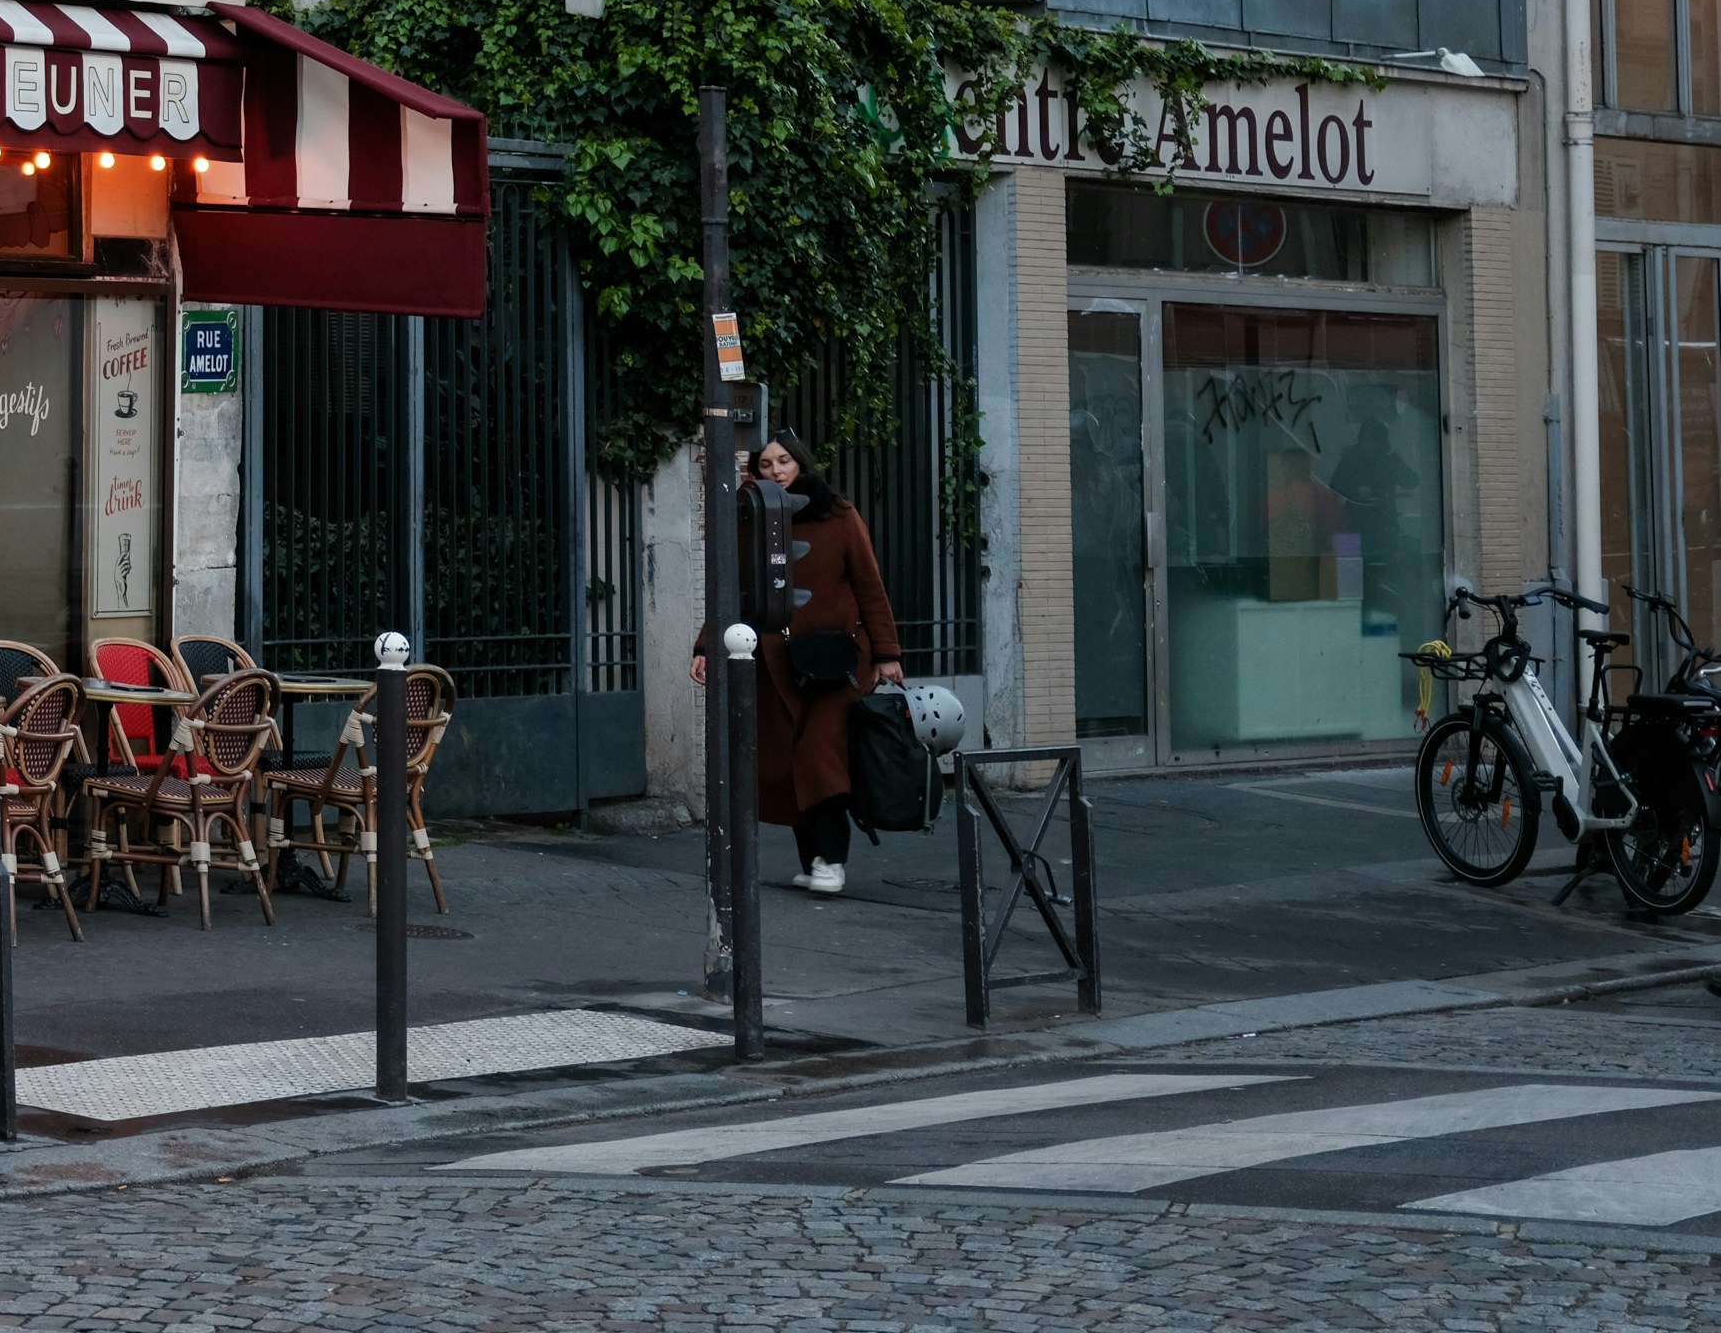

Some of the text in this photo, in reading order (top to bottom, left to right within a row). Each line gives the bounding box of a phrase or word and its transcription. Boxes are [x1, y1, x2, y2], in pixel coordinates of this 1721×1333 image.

[1150, 77, 1376, 186] Amelot
[107, 338, 124, 353] Fresh
[196, 330, 221, 349] RUE
[102, 346, 148, 381] COFFEE
[188, 352, 230, 375] AMELOT
[105, 479, 143, 517] drink
